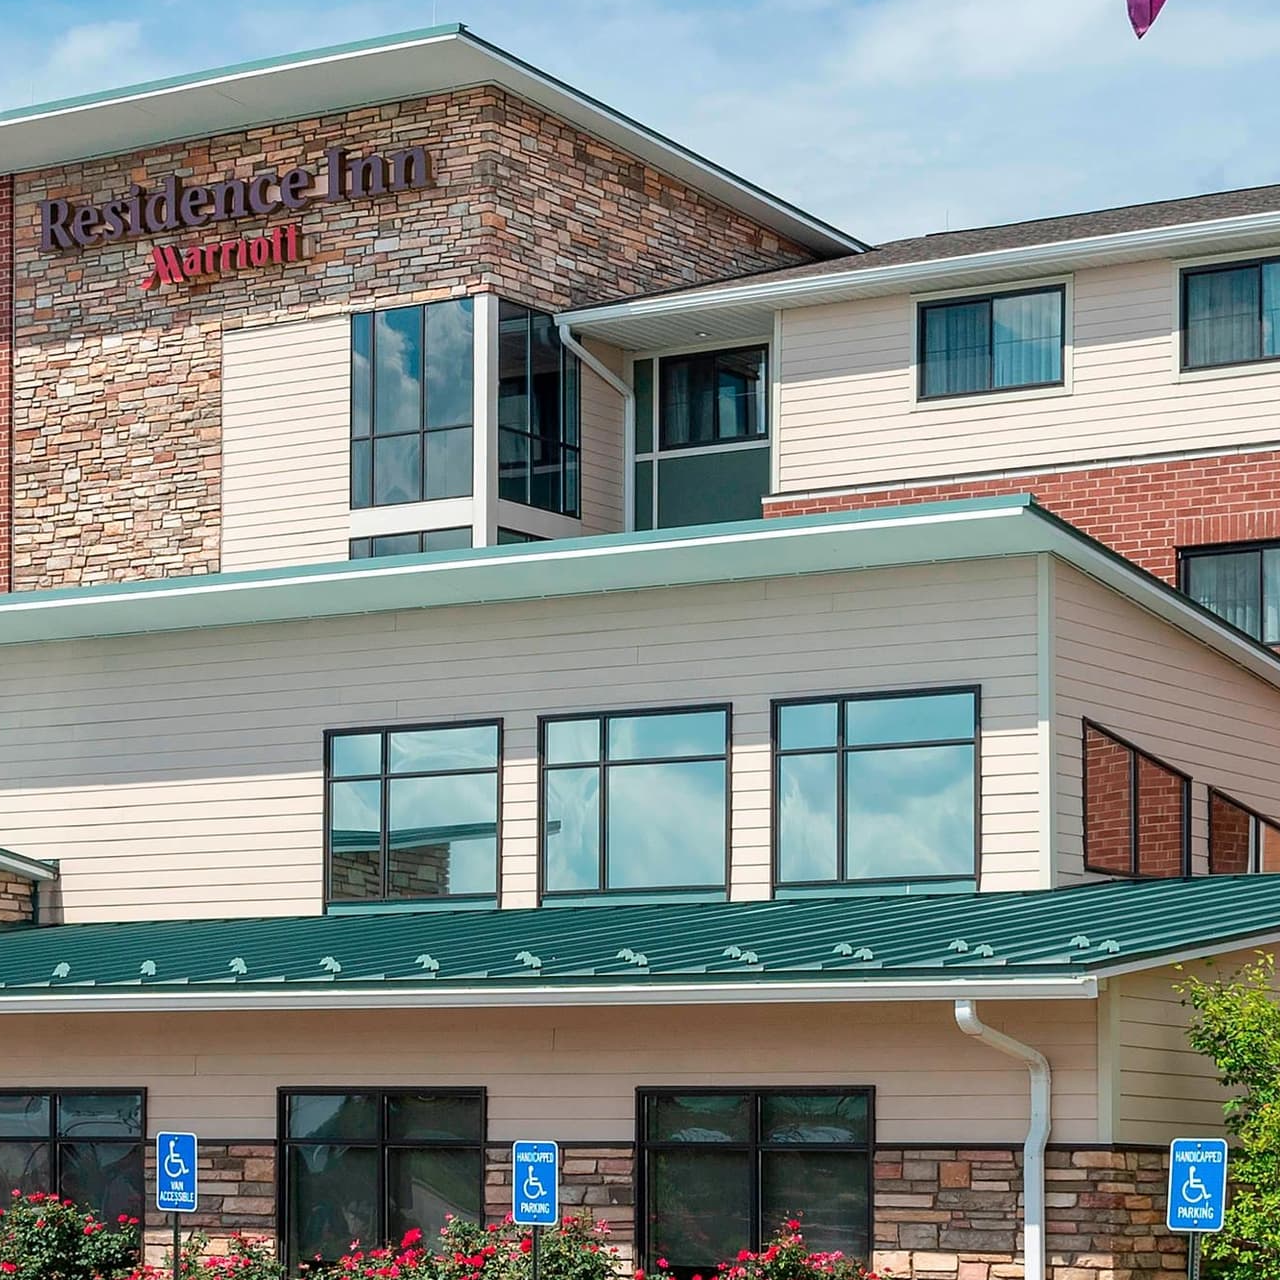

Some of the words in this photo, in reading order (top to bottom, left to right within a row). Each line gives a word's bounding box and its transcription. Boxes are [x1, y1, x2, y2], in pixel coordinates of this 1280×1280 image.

[38, 168, 312, 251] Residence
[324, 144, 434, 203] Inn
[138, 224, 302, 291] Marriott
[516, 1151, 554, 1163] HANDICAPPED
[1175, 1150, 1223, 1163] HANDICAPPED
[170, 1181, 184, 1191] VAN
[160, 1190, 195, 1203] ACCESSIBLE
[520, 1202, 550, 1214] PARKING
[1177, 1206, 1214, 1219] PARKING
